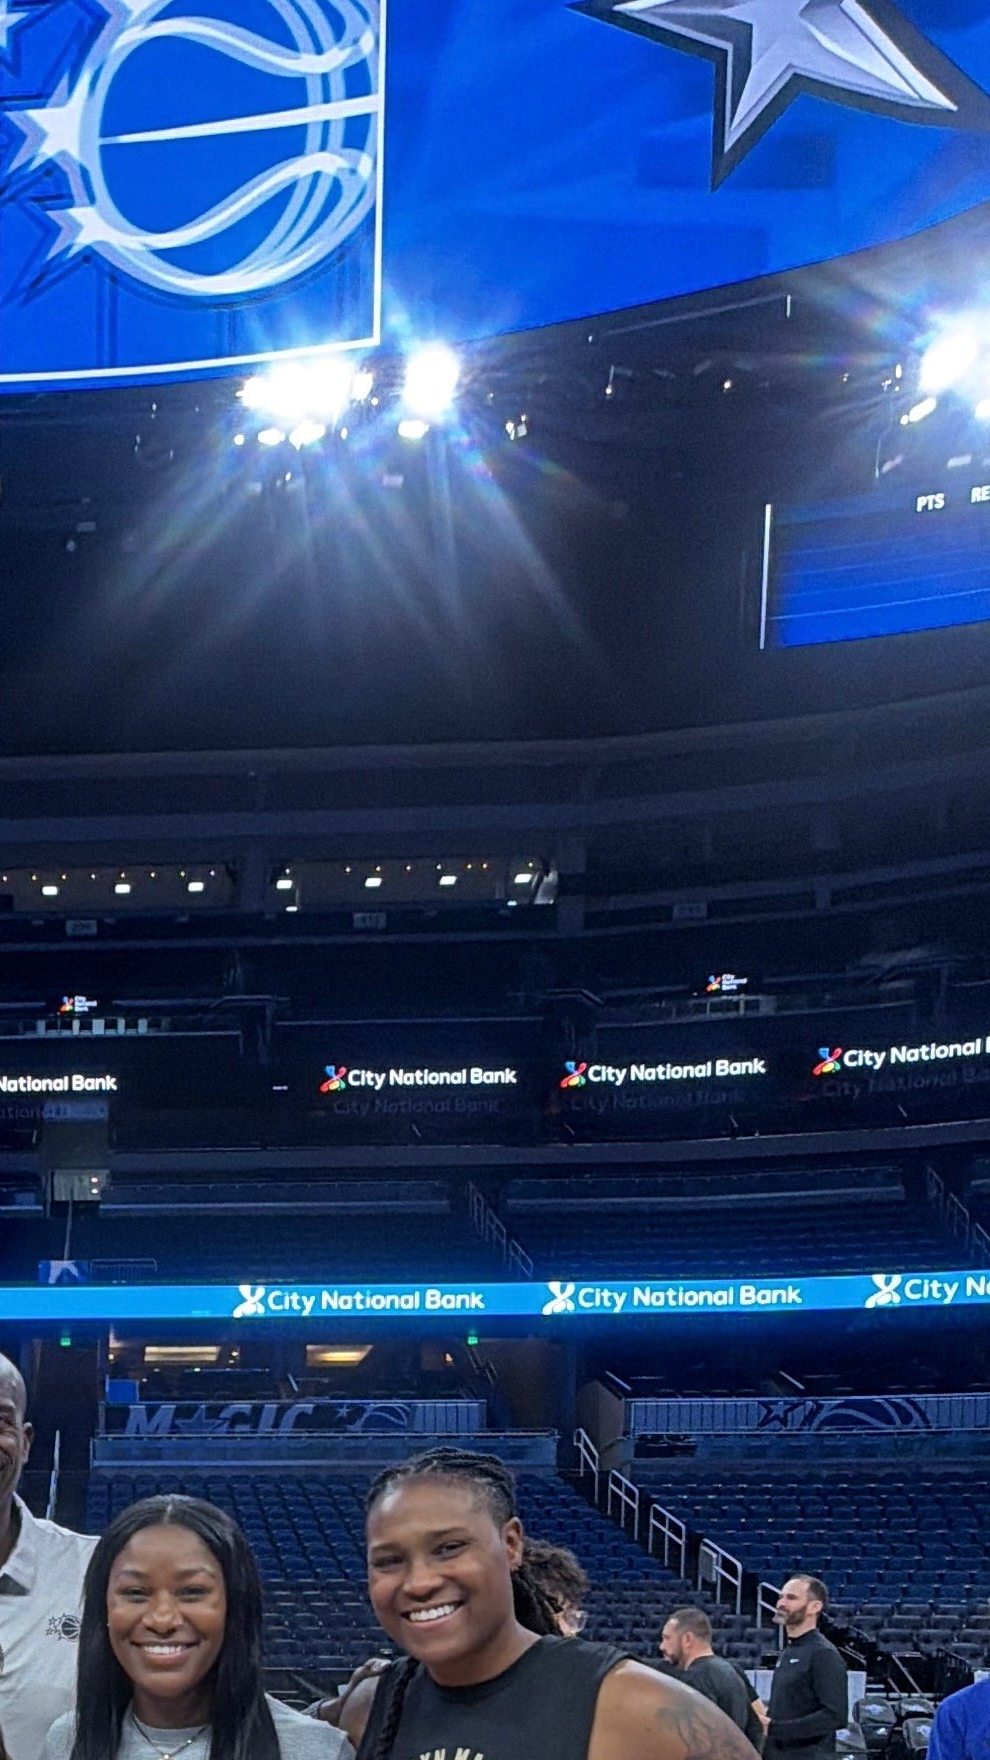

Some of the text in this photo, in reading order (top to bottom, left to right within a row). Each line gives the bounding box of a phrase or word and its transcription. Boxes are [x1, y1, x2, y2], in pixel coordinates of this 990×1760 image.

[916, 492, 946, 513] PTS
[842, 1049, 887, 1070] City
[890, 1038, 982, 1064] National
[71, 1074, 118, 1092] Bank
[347, 1067, 518, 1091] City National Bank
[587, 1056, 768, 1086] City National Bank
[267, 1289, 485, 1317] City National Bank
[578, 1285, 803, 1314] City National Bank
[904, 1278, 959, 1304] City
